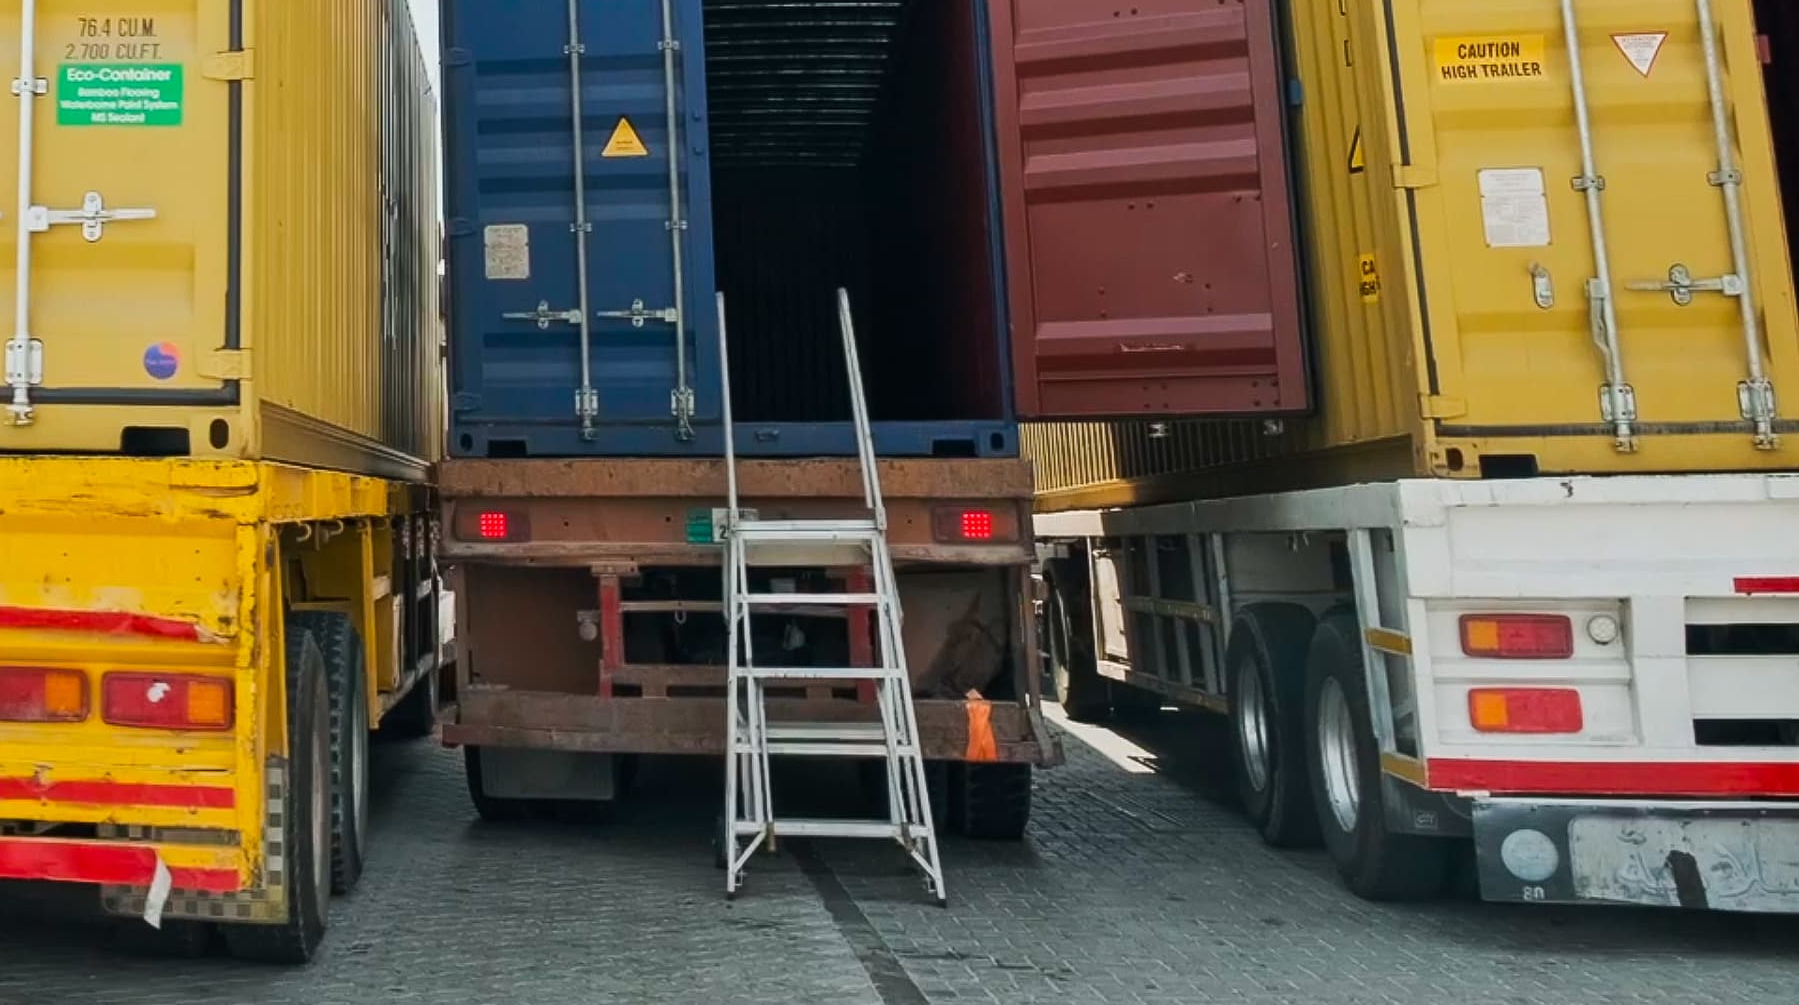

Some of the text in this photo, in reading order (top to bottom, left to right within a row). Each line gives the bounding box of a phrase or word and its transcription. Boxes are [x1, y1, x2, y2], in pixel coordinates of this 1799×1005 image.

[78, 18, 111, 37] 76.4
[65, 43, 110, 60] 2.700
[1458, 41, 1520, 60] CAUTION
[66, 67, 172, 82] Eco-Container
[1441, 61, 1543, 80] HIGH TRAILER
